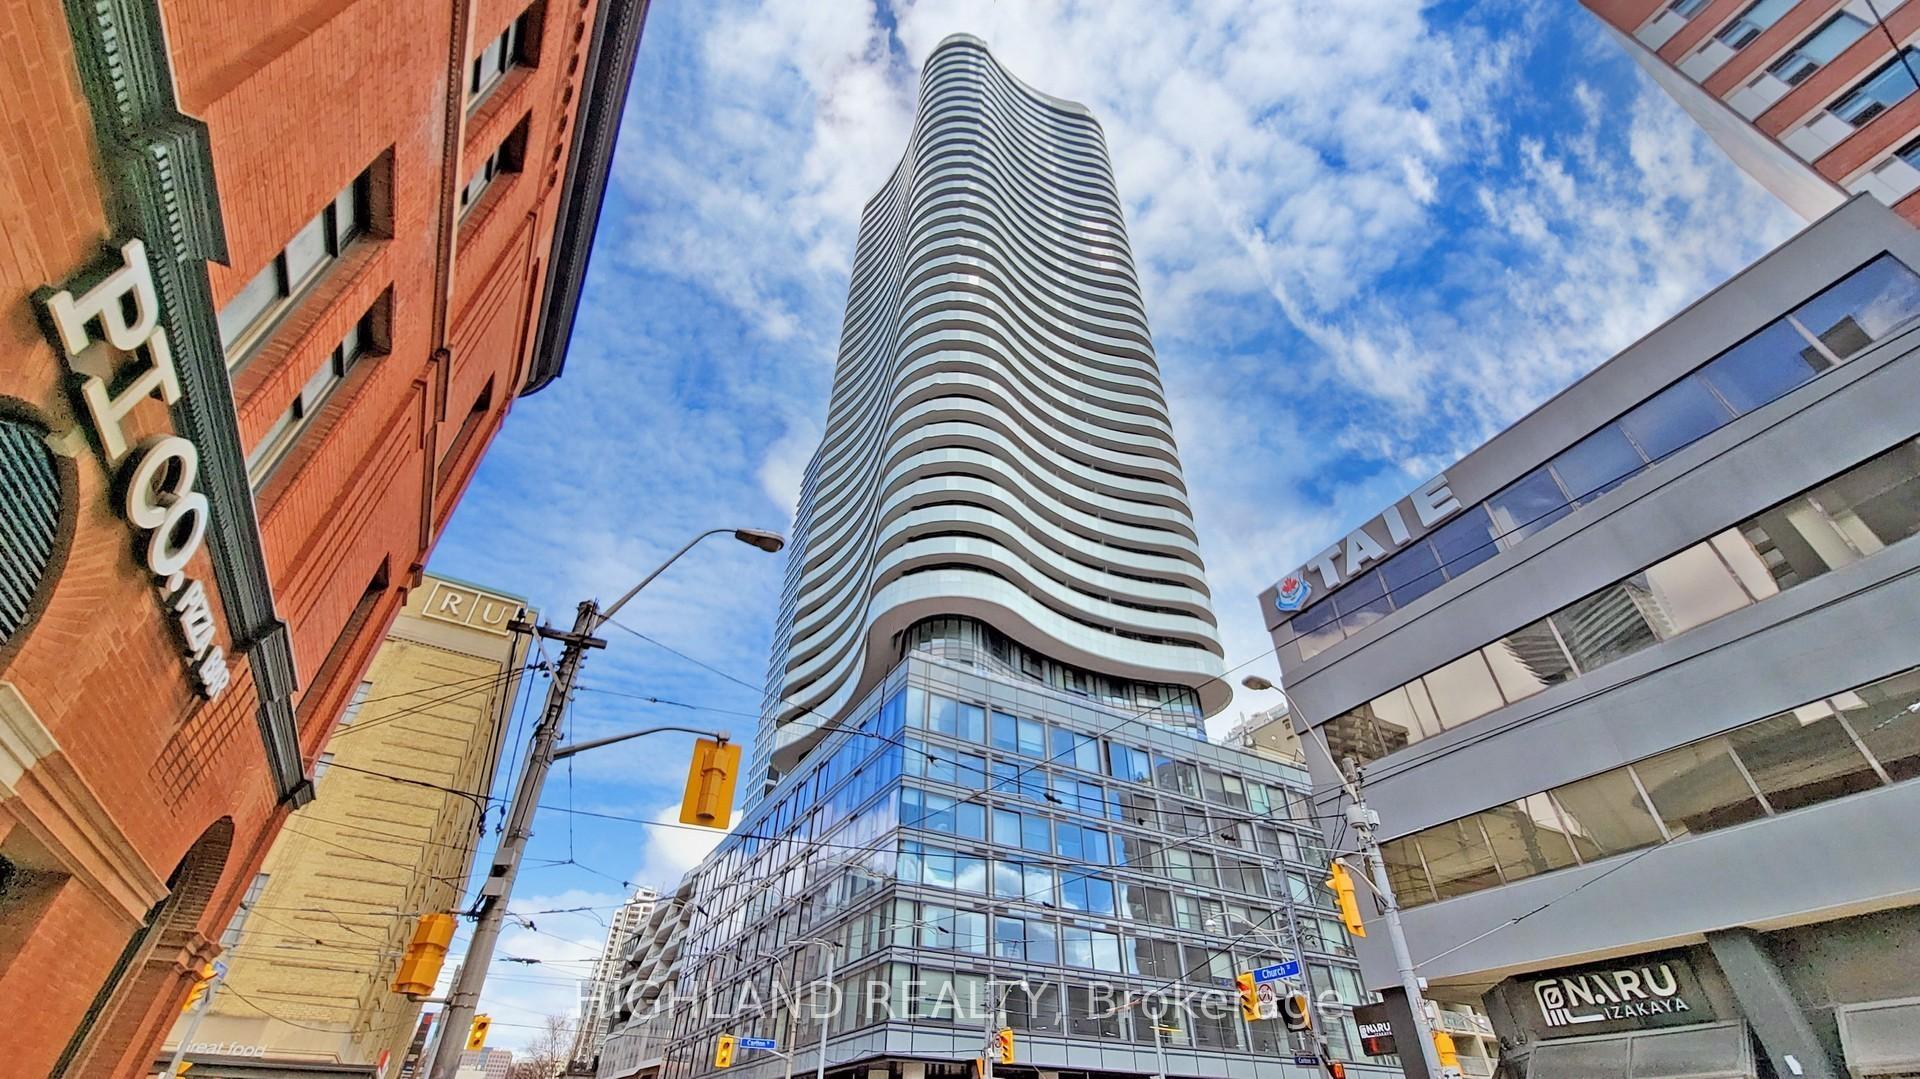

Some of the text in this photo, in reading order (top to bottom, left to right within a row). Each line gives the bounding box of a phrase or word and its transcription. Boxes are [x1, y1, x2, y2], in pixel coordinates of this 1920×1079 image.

[1306, 473, 1463, 589] TAIE
[1261, 965, 1286, 979] Church
[1605, 997, 1690, 1020] IZAKAYA
[226, 1041, 267, 1057] food
